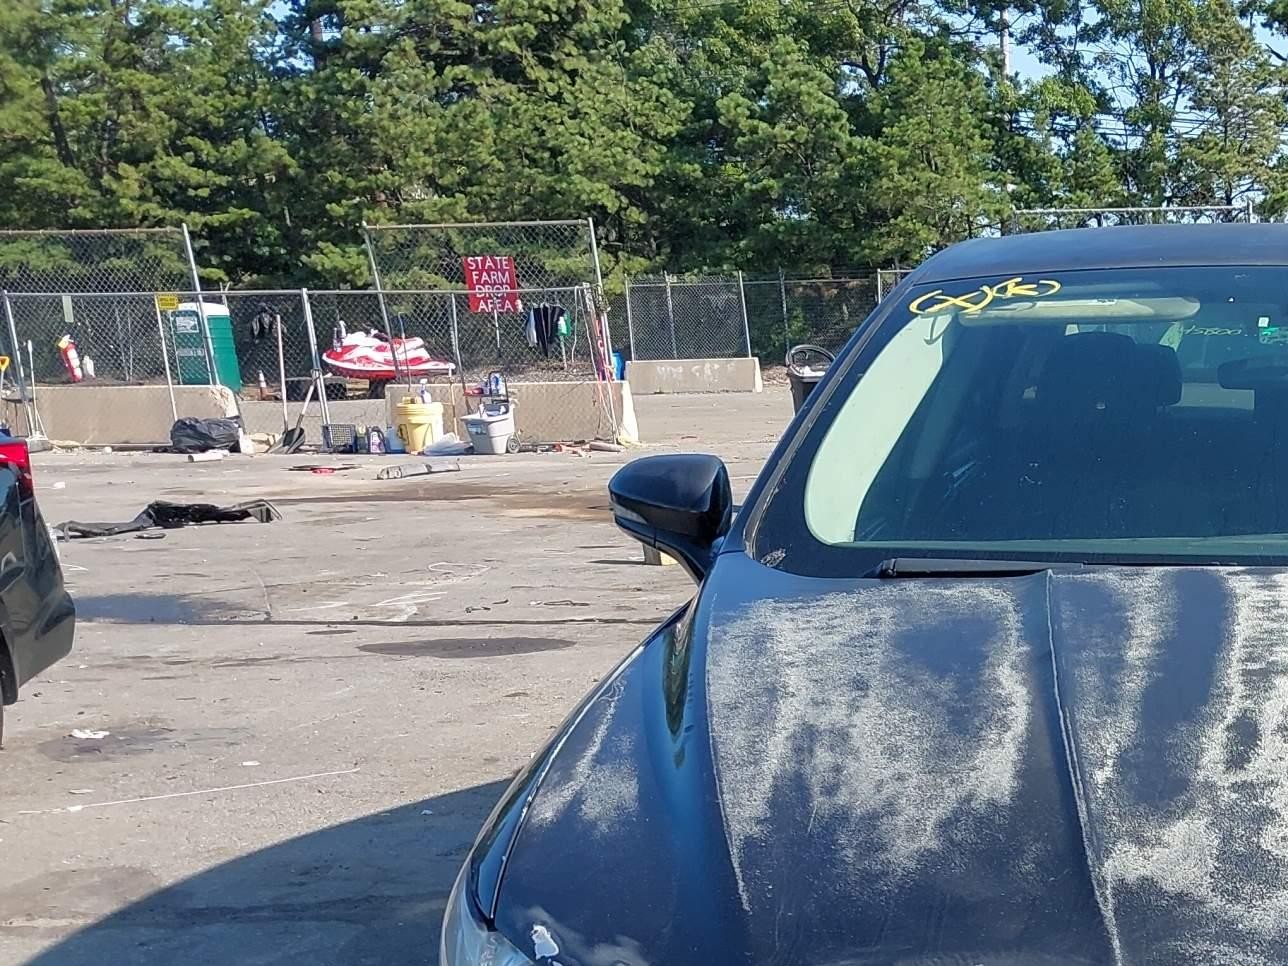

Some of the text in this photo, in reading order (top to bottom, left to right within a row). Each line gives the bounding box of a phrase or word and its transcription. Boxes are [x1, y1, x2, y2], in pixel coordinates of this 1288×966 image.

[467, 255, 510, 270] STATE
[472, 271, 510, 284] FARM
[475, 285, 510, 298] DROP
